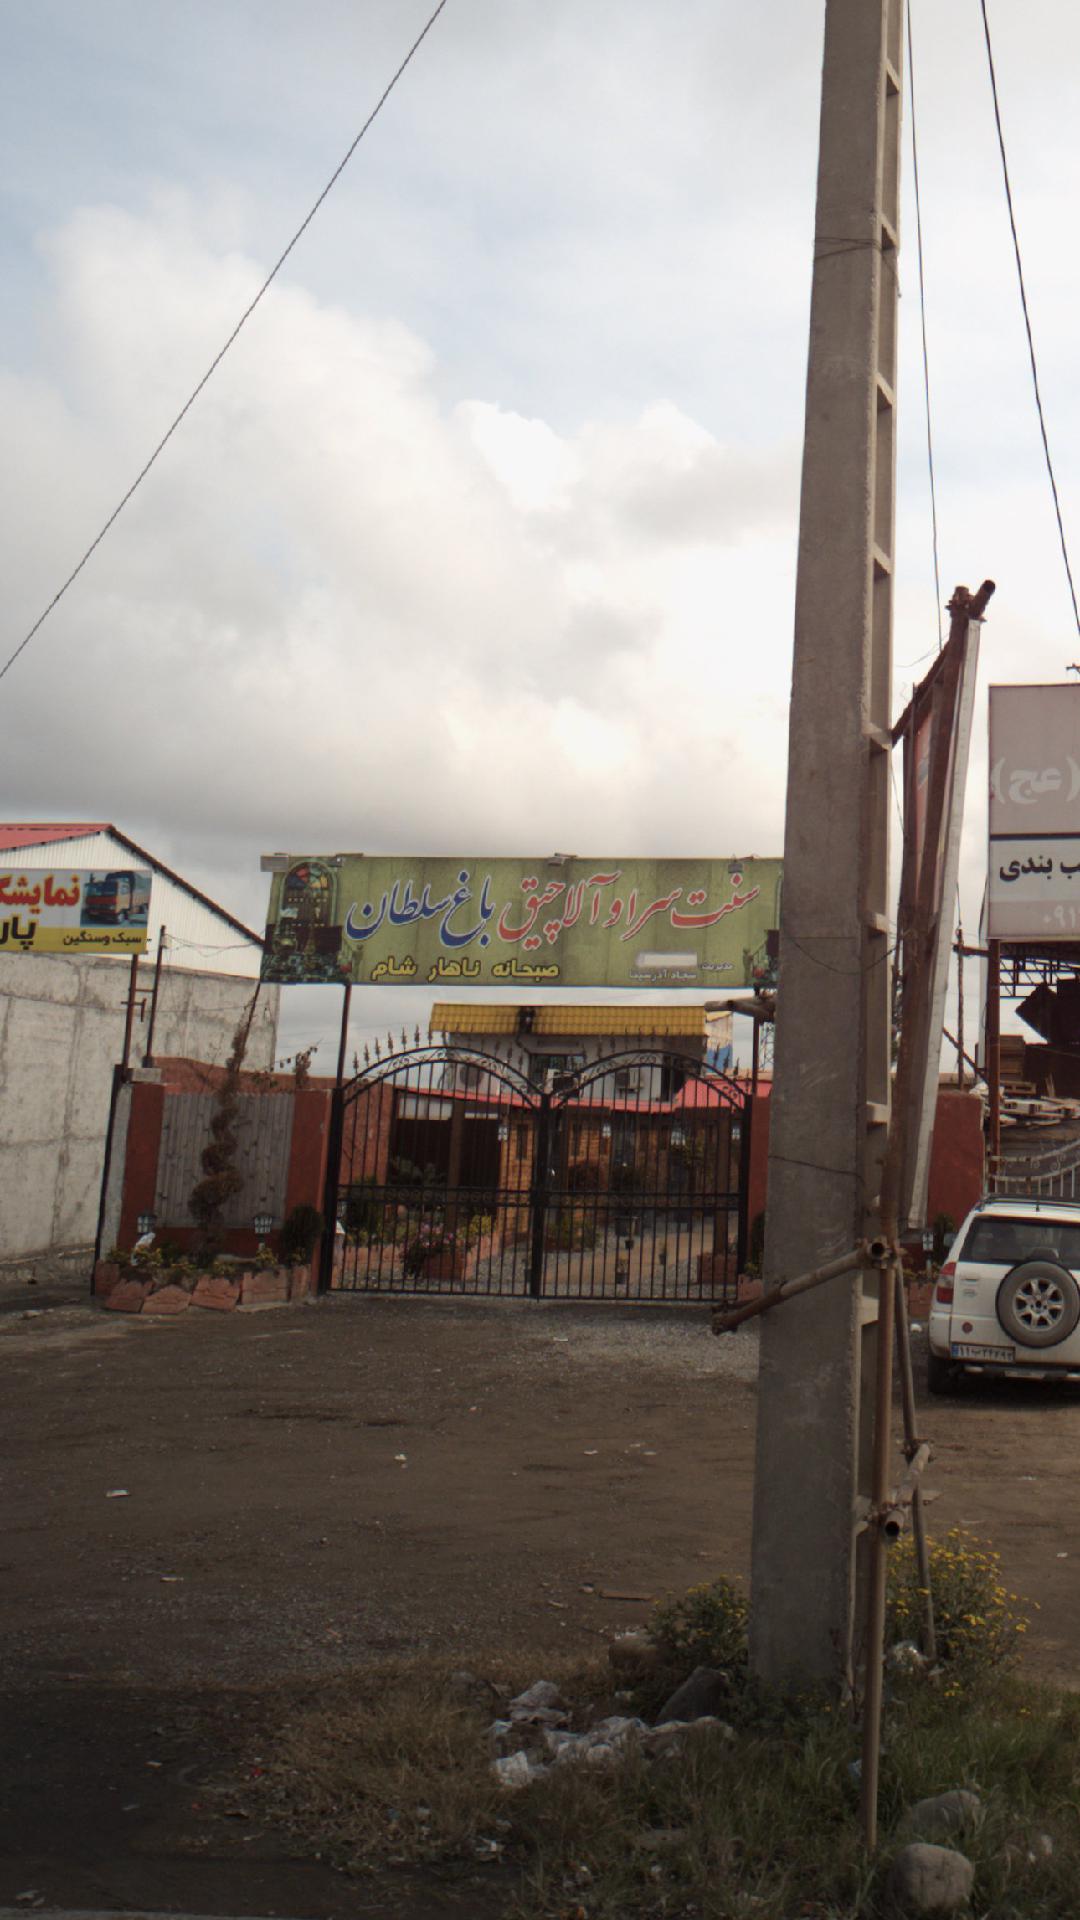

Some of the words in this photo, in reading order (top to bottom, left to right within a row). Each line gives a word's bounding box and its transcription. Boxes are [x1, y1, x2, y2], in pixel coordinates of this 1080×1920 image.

[999, 855, 1053, 882] بندی
[345, 879, 453, 940] سلطان
[440, 870, 496, 948] باغ
[371, 955, 417, 981] شام
[427, 956, 481, 983] ناهار
[491, 956, 560, 982] صبحانه
